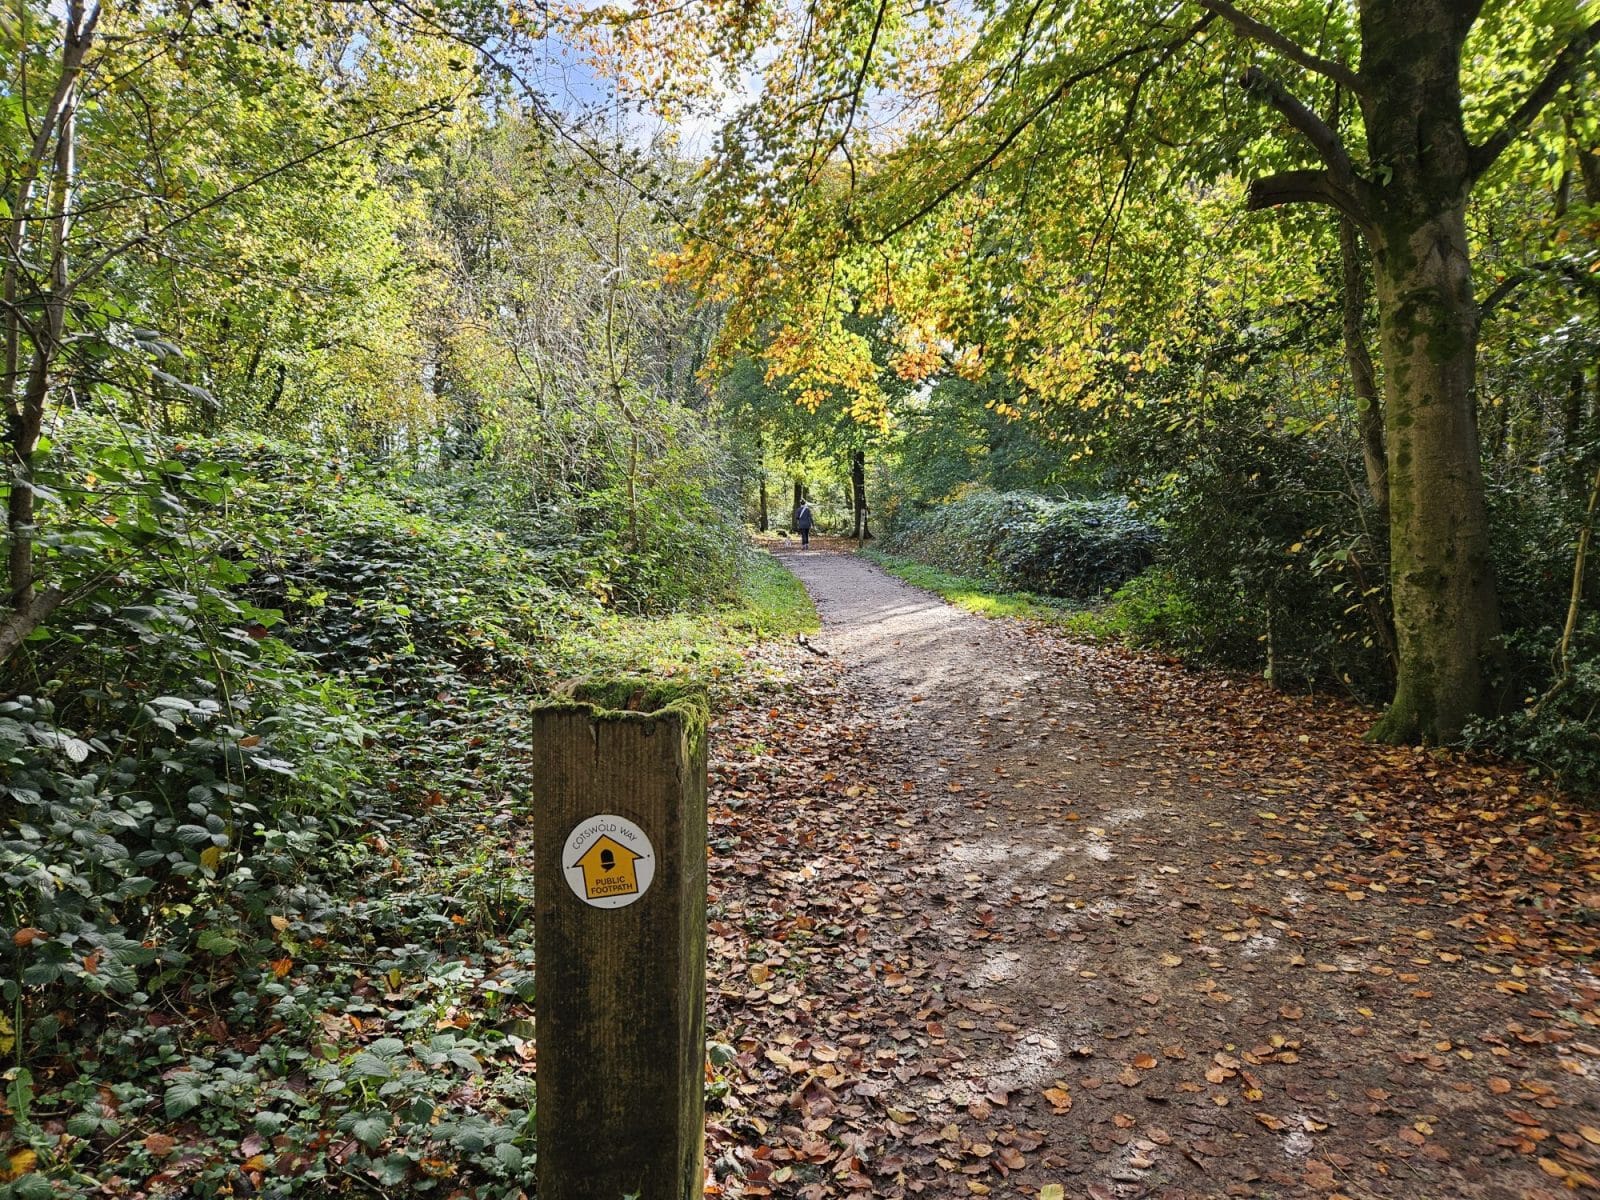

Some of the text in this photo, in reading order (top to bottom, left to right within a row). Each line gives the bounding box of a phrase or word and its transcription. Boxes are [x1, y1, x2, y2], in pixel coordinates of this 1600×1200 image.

[572, 823, 638, 850] COTSWOLD WAY
[595, 875, 625, 886] PUBLIC
[591, 883, 633, 895] FOOTPATH
